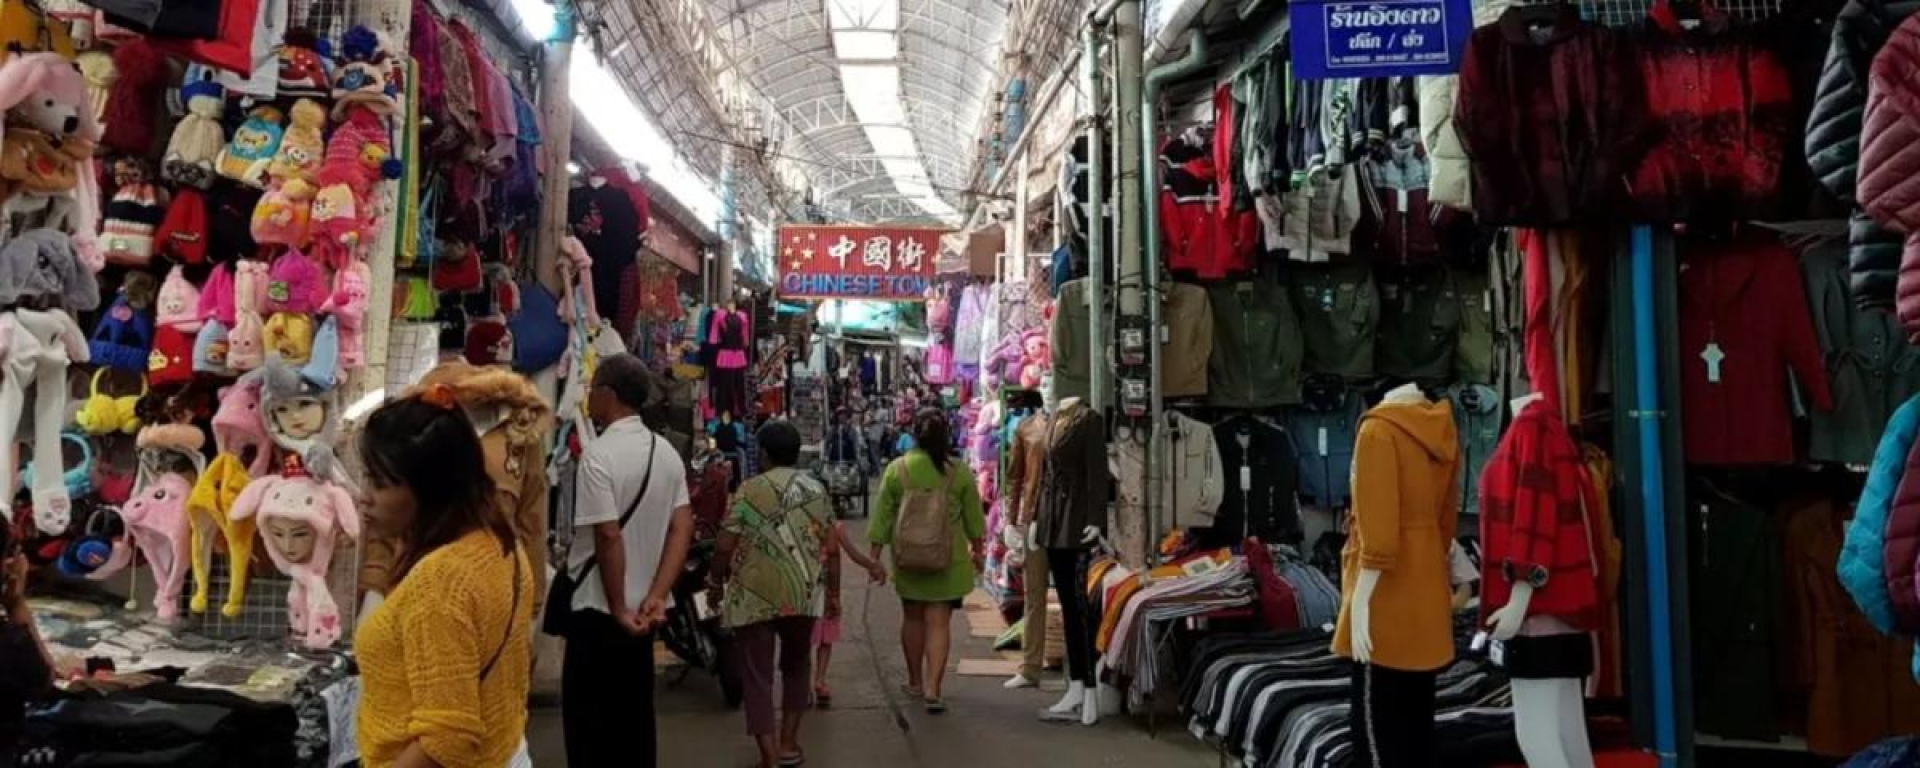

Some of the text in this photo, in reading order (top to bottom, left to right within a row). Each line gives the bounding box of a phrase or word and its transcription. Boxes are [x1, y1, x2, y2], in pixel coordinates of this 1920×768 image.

[1387, 32, 1396, 50] /
[828, 235, 926, 272] 中國街
[784, 272, 880, 295] CHINESE
